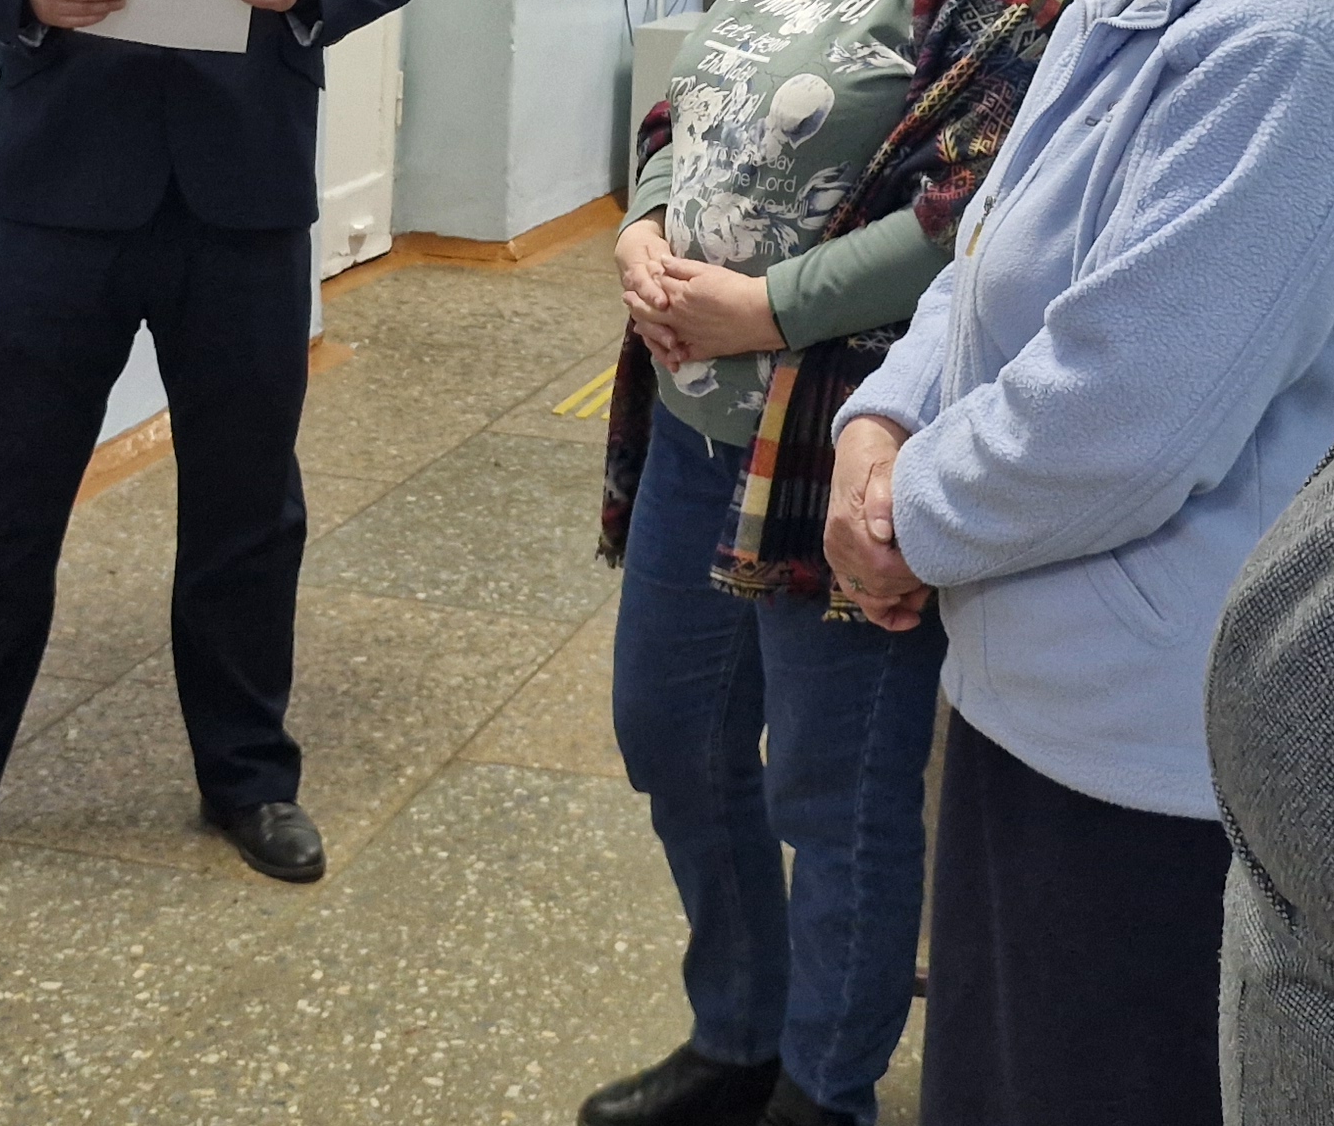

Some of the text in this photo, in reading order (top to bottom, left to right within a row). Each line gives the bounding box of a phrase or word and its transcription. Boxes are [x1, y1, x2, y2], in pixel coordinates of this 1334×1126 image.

[755, 170, 797, 192] Lord
[750, 195, 809, 217] we will
